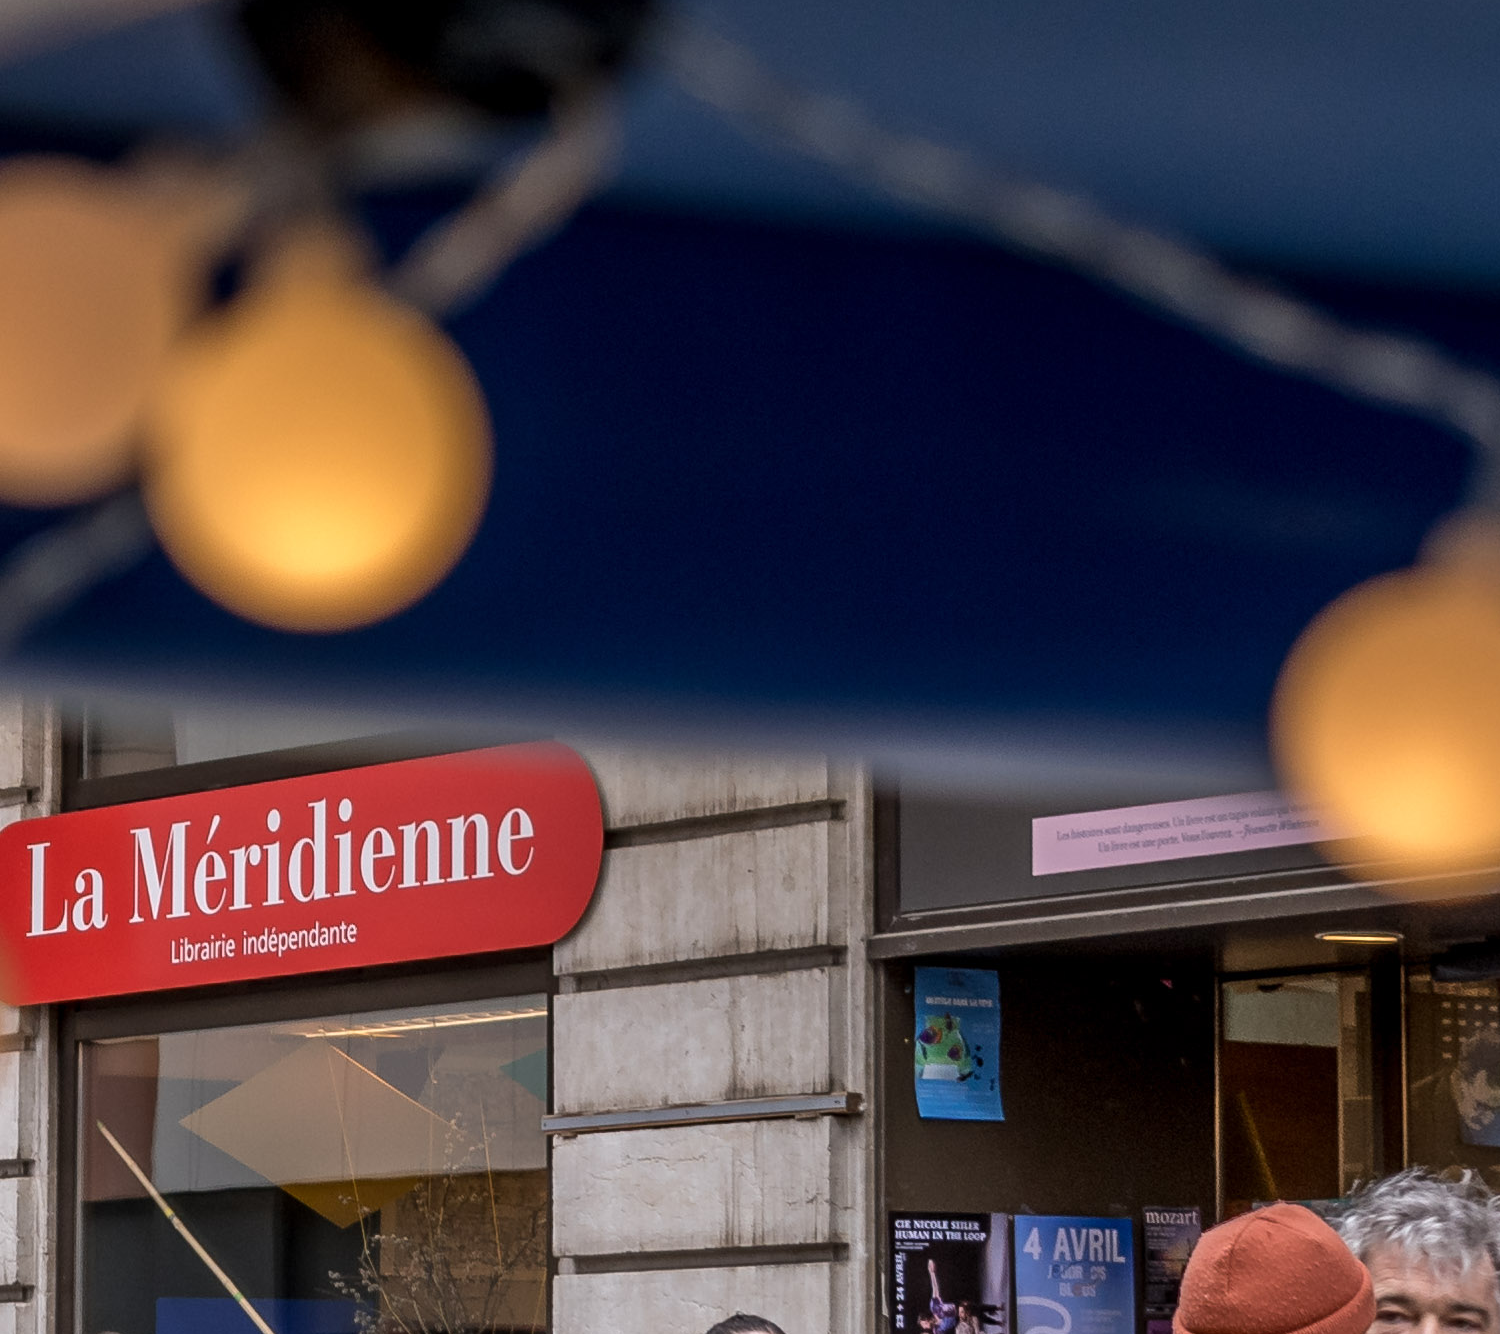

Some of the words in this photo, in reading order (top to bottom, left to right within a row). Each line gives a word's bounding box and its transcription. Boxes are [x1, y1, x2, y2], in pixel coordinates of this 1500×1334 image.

[25, 842, 108, 937] La
[128, 797, 535, 924] Méridienne
[170, 931, 236, 964] Librairie
[242, 921, 358, 958] indépendante
[913, 1219, 949, 1229] NICOLE
[1145, 1210, 1198, 1225] mozart
[895, 1229, 930, 1240] HUMAN
[932, 1230, 943, 1240] IN
[946, 1231, 962, 1241] THE
[963, 1232, 987, 1242] LOOP
[1023, 1227, 1042, 1260] 4
[1053, 1227, 1126, 1263] AVRIL
